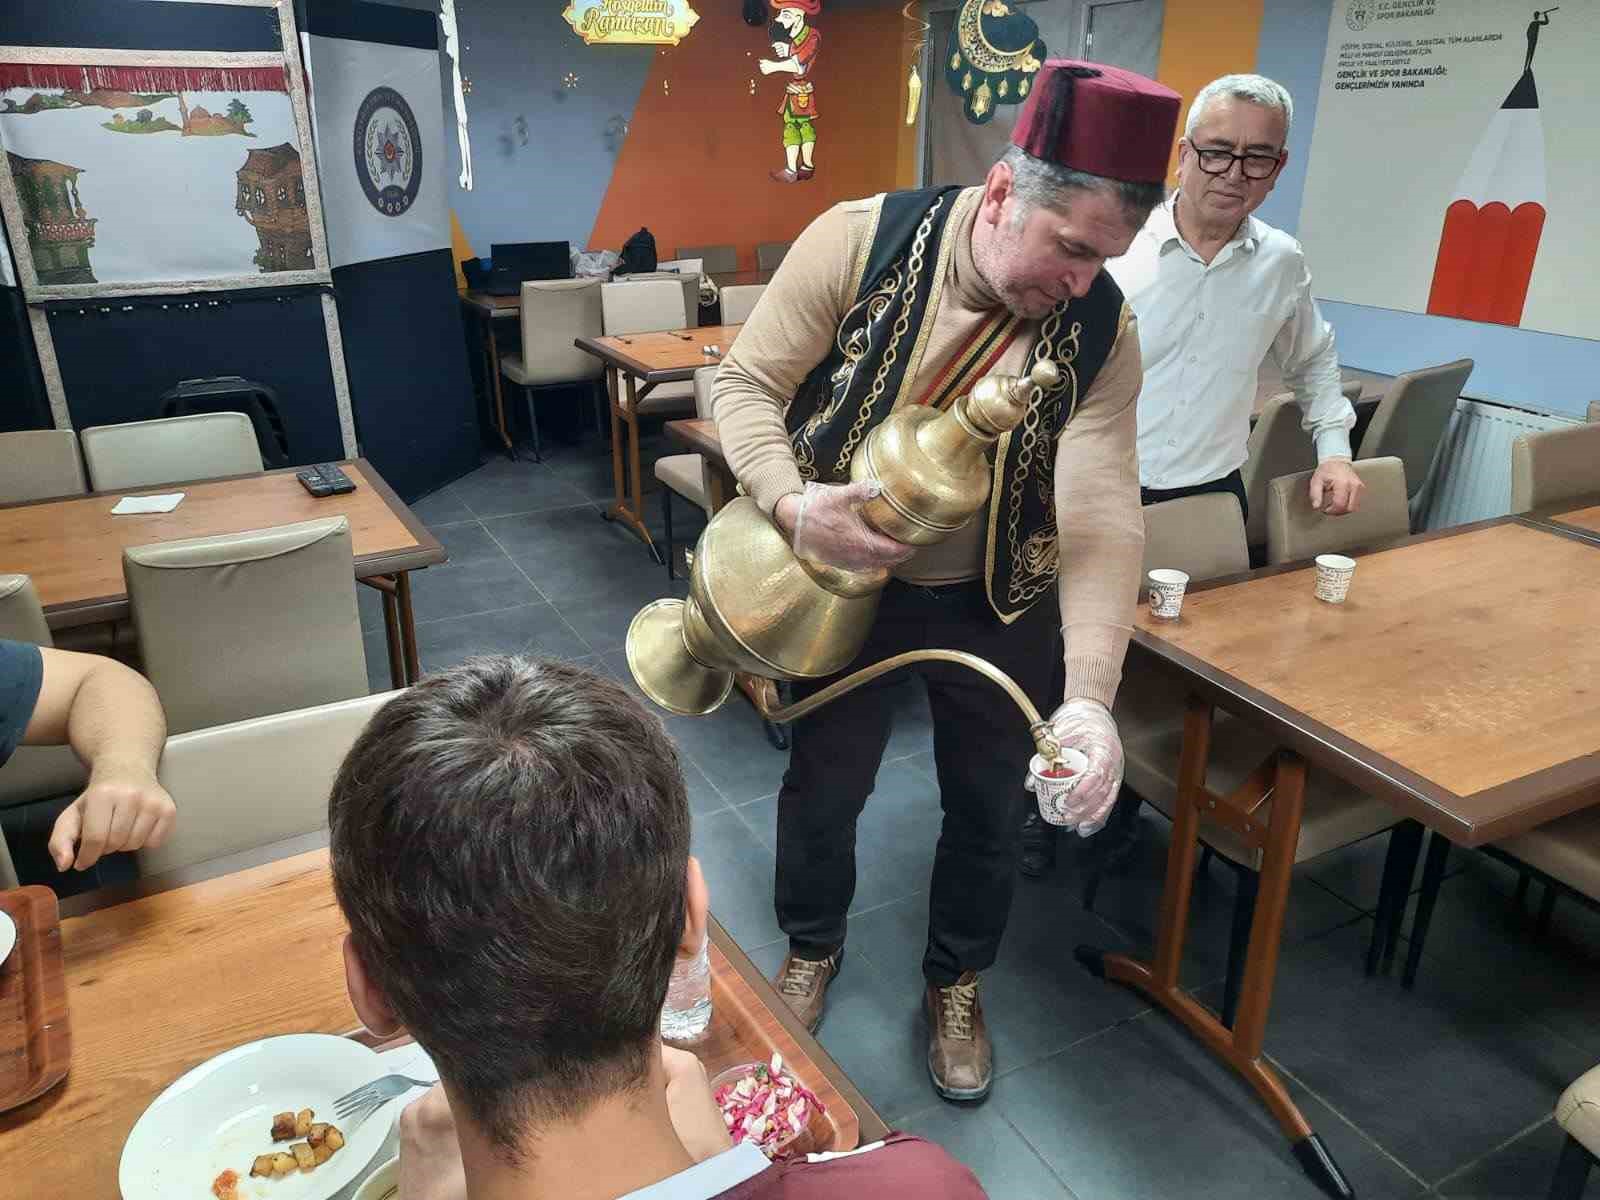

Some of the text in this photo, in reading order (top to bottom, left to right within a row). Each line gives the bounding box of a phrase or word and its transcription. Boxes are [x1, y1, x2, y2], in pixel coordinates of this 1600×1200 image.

[1377, 11, 1395, 19] SPOR
[581, 7, 675, 38] Ramazan
[1336, 70, 1367, 79] GENÇLİK
[1368, 69, 1378, 77] VE
[1379, 69, 1400, 78] SPOR
[1335, 79, 1425, 92] GENÇLERİMİZİN YANINDA
